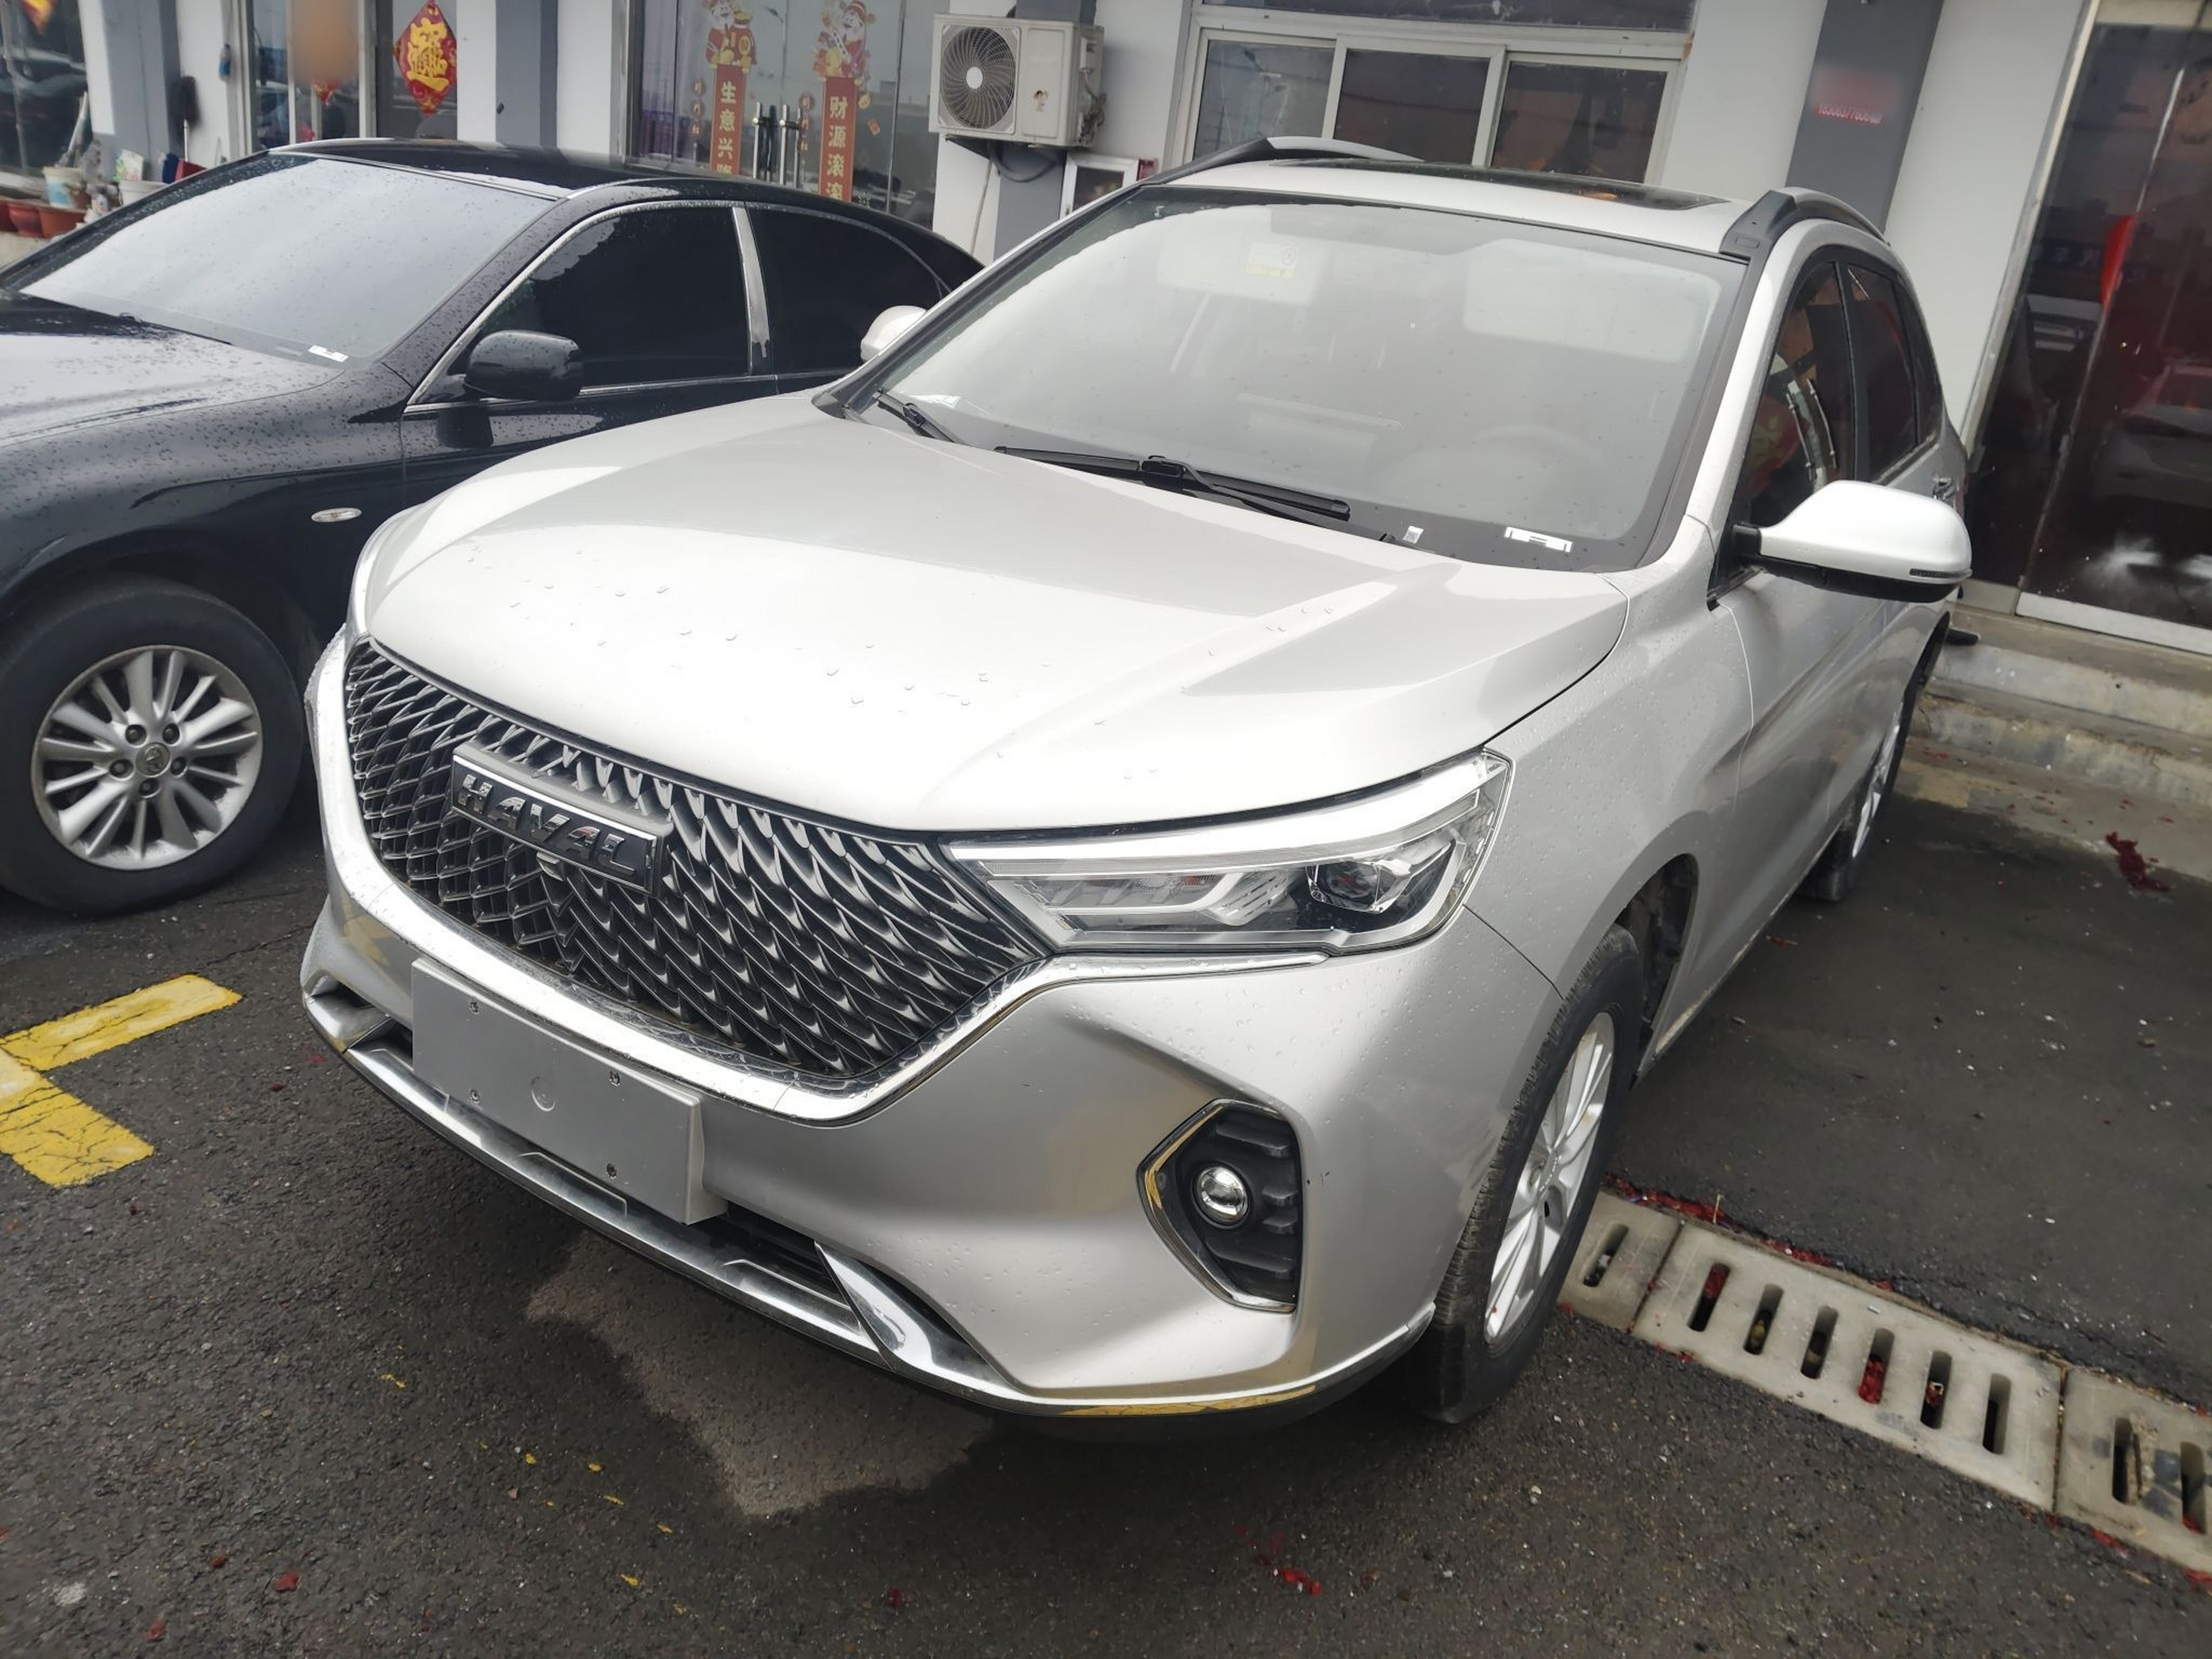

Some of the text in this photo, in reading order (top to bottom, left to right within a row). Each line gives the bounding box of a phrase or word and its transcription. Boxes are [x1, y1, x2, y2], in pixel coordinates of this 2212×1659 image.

[826, 96, 849, 200] 财源滚滚
[457, 774, 635, 876] HAVAL
